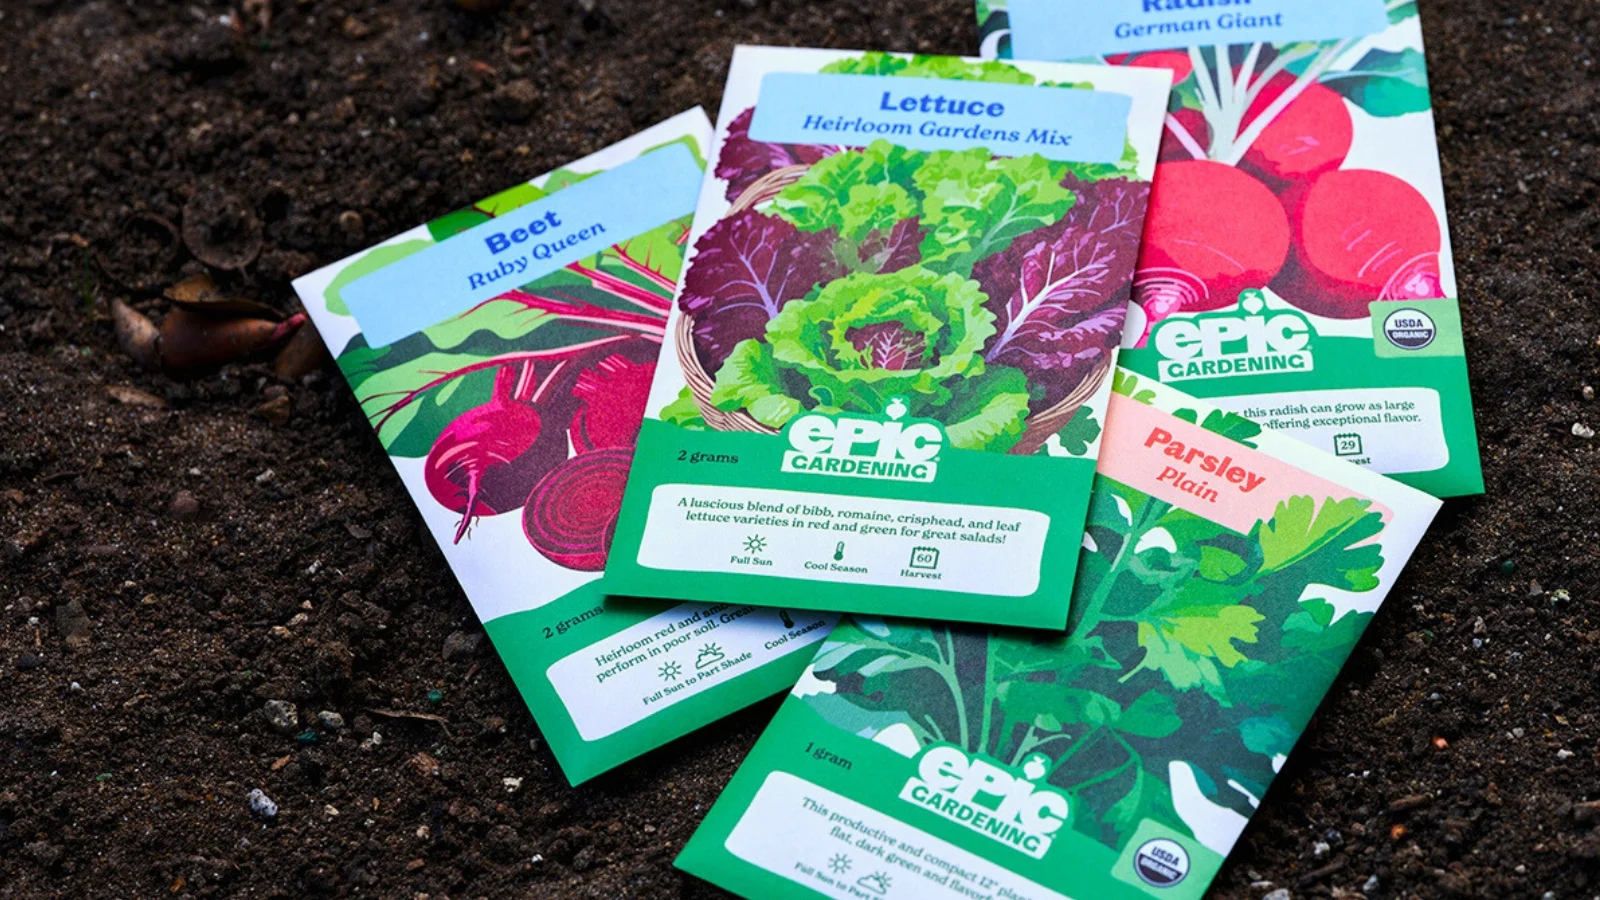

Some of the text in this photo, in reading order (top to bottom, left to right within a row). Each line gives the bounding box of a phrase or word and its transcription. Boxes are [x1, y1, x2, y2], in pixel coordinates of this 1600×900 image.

[1114, 12, 1283, 39] German Giant
[879, 91, 1006, 118] Lettuce
[801, 114, 1074, 148] Heirloom Gardens Mix
[484, 210, 562, 255] Beet
[467, 222, 606, 291] Ruby Queen
[1391, 329, 1430, 340] ORGANIC
[1394, 318, 1423, 328] USDA
[1167, 354, 1305, 378] GARDENING
[1243, 407, 1267, 418] this
[1269, 404, 1308, 417] radish
[1311, 406, 1333, 414] can
[1334, 404, 1366, 413] grow
[1368, 403, 1382, 411] as
[1384, 401, 1416, 412] large
[1312, 413, 1382, 428] exceptional
[1384, 413, 1422, 424] flavor.
[677, 450, 739, 465] 2 grams
[1144, 426, 1267, 493] Parsley
[1340, 441, 1356, 450] 29
[791, 454, 928, 479] GARDENING
[1156, 465, 1219, 503] Plain
[676, 497, 1022, 532] A luscious blend of bibb, romaine, crisphead, and leaf
[685, 511, 1007, 544] lettuce varieties in red and green for great salads!
[730, 555, 773, 566] Full Sun
[804, 561, 868, 574] Cool Season
[916, 554, 932, 563] 60
[900, 569, 942, 580] Harvest
[542, 605, 604, 639] 2 grams
[764, 619, 826, 651] Cool Season
[594, 636, 654, 667] Heirloom
[654, 624, 677, 640] red
[677, 612, 702, 629] and
[596, 605, 756, 683] perform in poor soil. Great
[642, 652, 752, 706] Full Sun to Part Shade
[804, 742, 853, 771] 1 gram
[910, 785, 1042, 852] GARDENING
[801, 796, 829, 816] This
[829, 811, 897, 846] productive
[897, 842, 924, 858] and
[923, 852, 978, 883] compact
[829, 825, 852, 845] flat,
[855, 838, 885, 858] dark
[885, 852, 922, 875] green
[923, 868, 949, 886] and
[1151, 846, 1180, 866] USDA
[794, 861, 815, 876] Full
[814, 870, 835, 886] Sun
[836, 880, 848, 891] to
